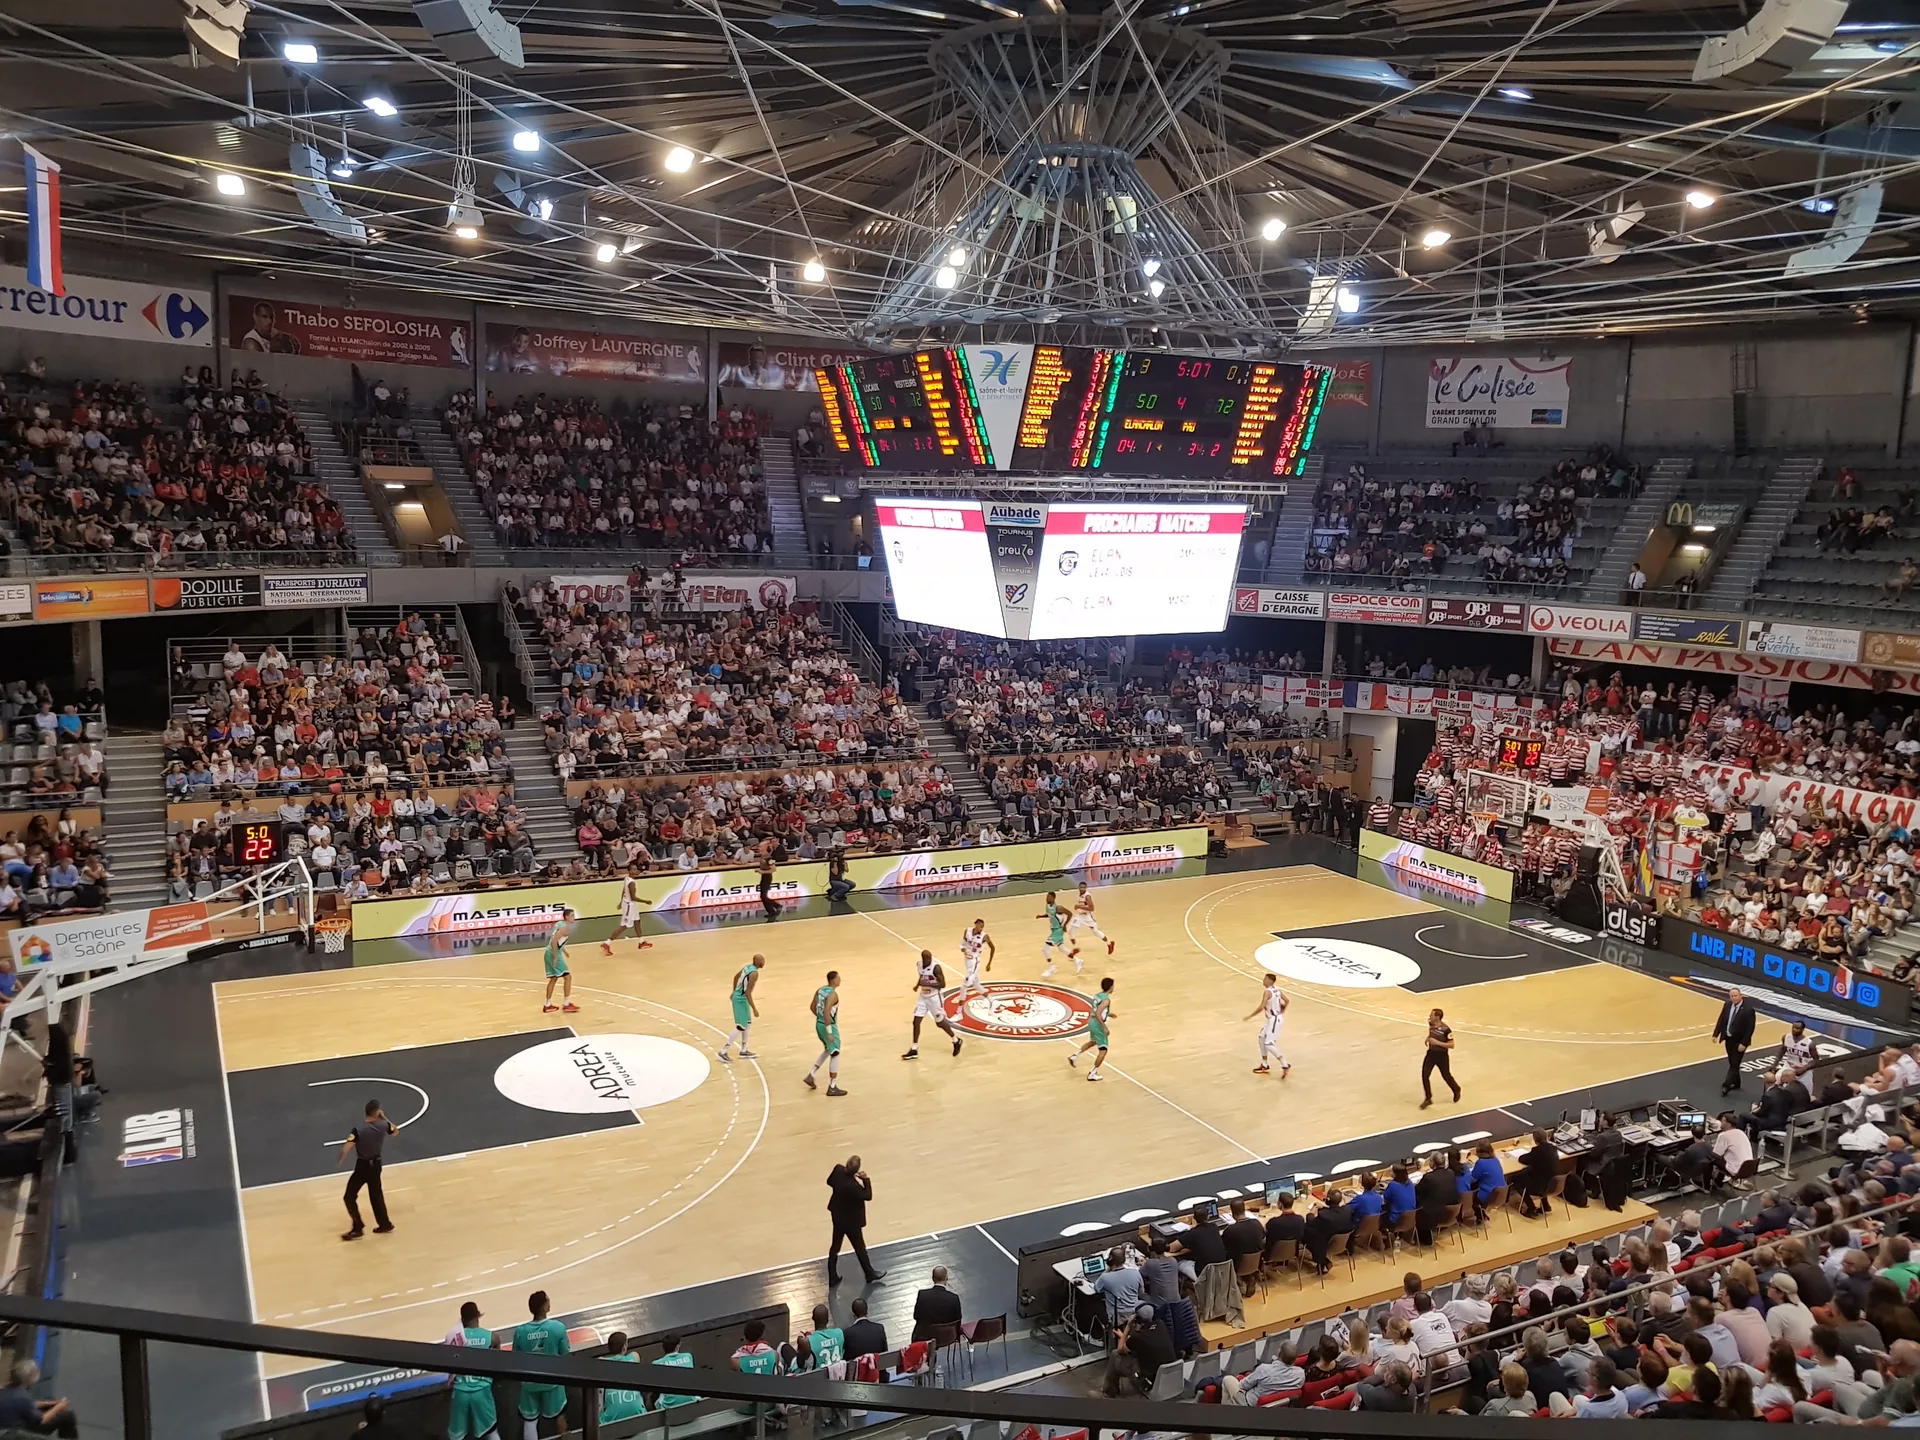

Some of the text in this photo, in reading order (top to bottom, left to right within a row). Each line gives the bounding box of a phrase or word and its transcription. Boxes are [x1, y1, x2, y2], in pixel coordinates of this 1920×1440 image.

[284, 309, 442, 338] Thabo SEFOLOSHA
[309, 334, 330, 342] Formé
[414, 343, 431, 351] 2005
[533, 334, 684, 358] Joffrey LAUVERGNE
[375, 350, 386, 358] par
[397, 351, 422, 361] Chicago
[423, 353, 438, 361] Bulls
[774, 352, 816, 367] Clint
[1140, 359, 1238, 380] 3 5:07 0
[863, 378, 917, 392] LOCAUX VISITEURS
[979, 387, 1023, 395] saône-et-loire
[1458, 364, 1536, 404] Colisée
[871, 396, 882, 410] 50
[1136, 394, 1235, 414] 50 4 72
[1431, 416, 1497, 425] GRAND CHALON
[990, 506, 1041, 519] Aubade
[1084, 514, 1210, 533] PROCHAINS MATCHS
[181, 579, 243, 594] DODILLE
[268, 578, 362, 589] TRANSPORTS DURIAUT
[181, 595, 244, 608] PUBLICITE
[270, 589, 362, 598] NATIONAL INTERNATIONAL
[560, 584, 625, 603] TOUS
[1274, 592, 1310, 602] CAISSE
[1262, 604, 1319, 615] D'EPARGNE
[1558, 615, 1628, 633] VEOLIA
[1694, 624, 1730, 643] RAVE
[1756, 642, 1801, 655] events
[1549, 637, 1661, 663] ELAN
[1674, 646, 1875, 686] PASSION
[1502, 750, 1518, 763] 22
[1524, 751, 1538, 765] 22
[246, 839, 272, 860] 22
[1101, 844, 1174, 858] MASTER'S
[915, 861, 999, 876] MASTER'S
[919, 871, 998, 883] CONSTRUCTION
[1409, 857, 1478, 884] MASTER'S
[453, 903, 566, 922] MASTER'S
[458, 914, 565, 929] CONSTRUCTION
[1608, 907, 1647, 939] dlsi
[55, 921, 142, 946] Demeures
[75, 938, 126, 958] Saône
[1691, 932, 1756, 968] LNB.FR
[1294, 943, 1382, 980] ADREA
[569, 1043, 630, 1100] ADREA
[604, 1051, 637, 1087] mutuelle
[819, 1346, 841, 1368] 34
